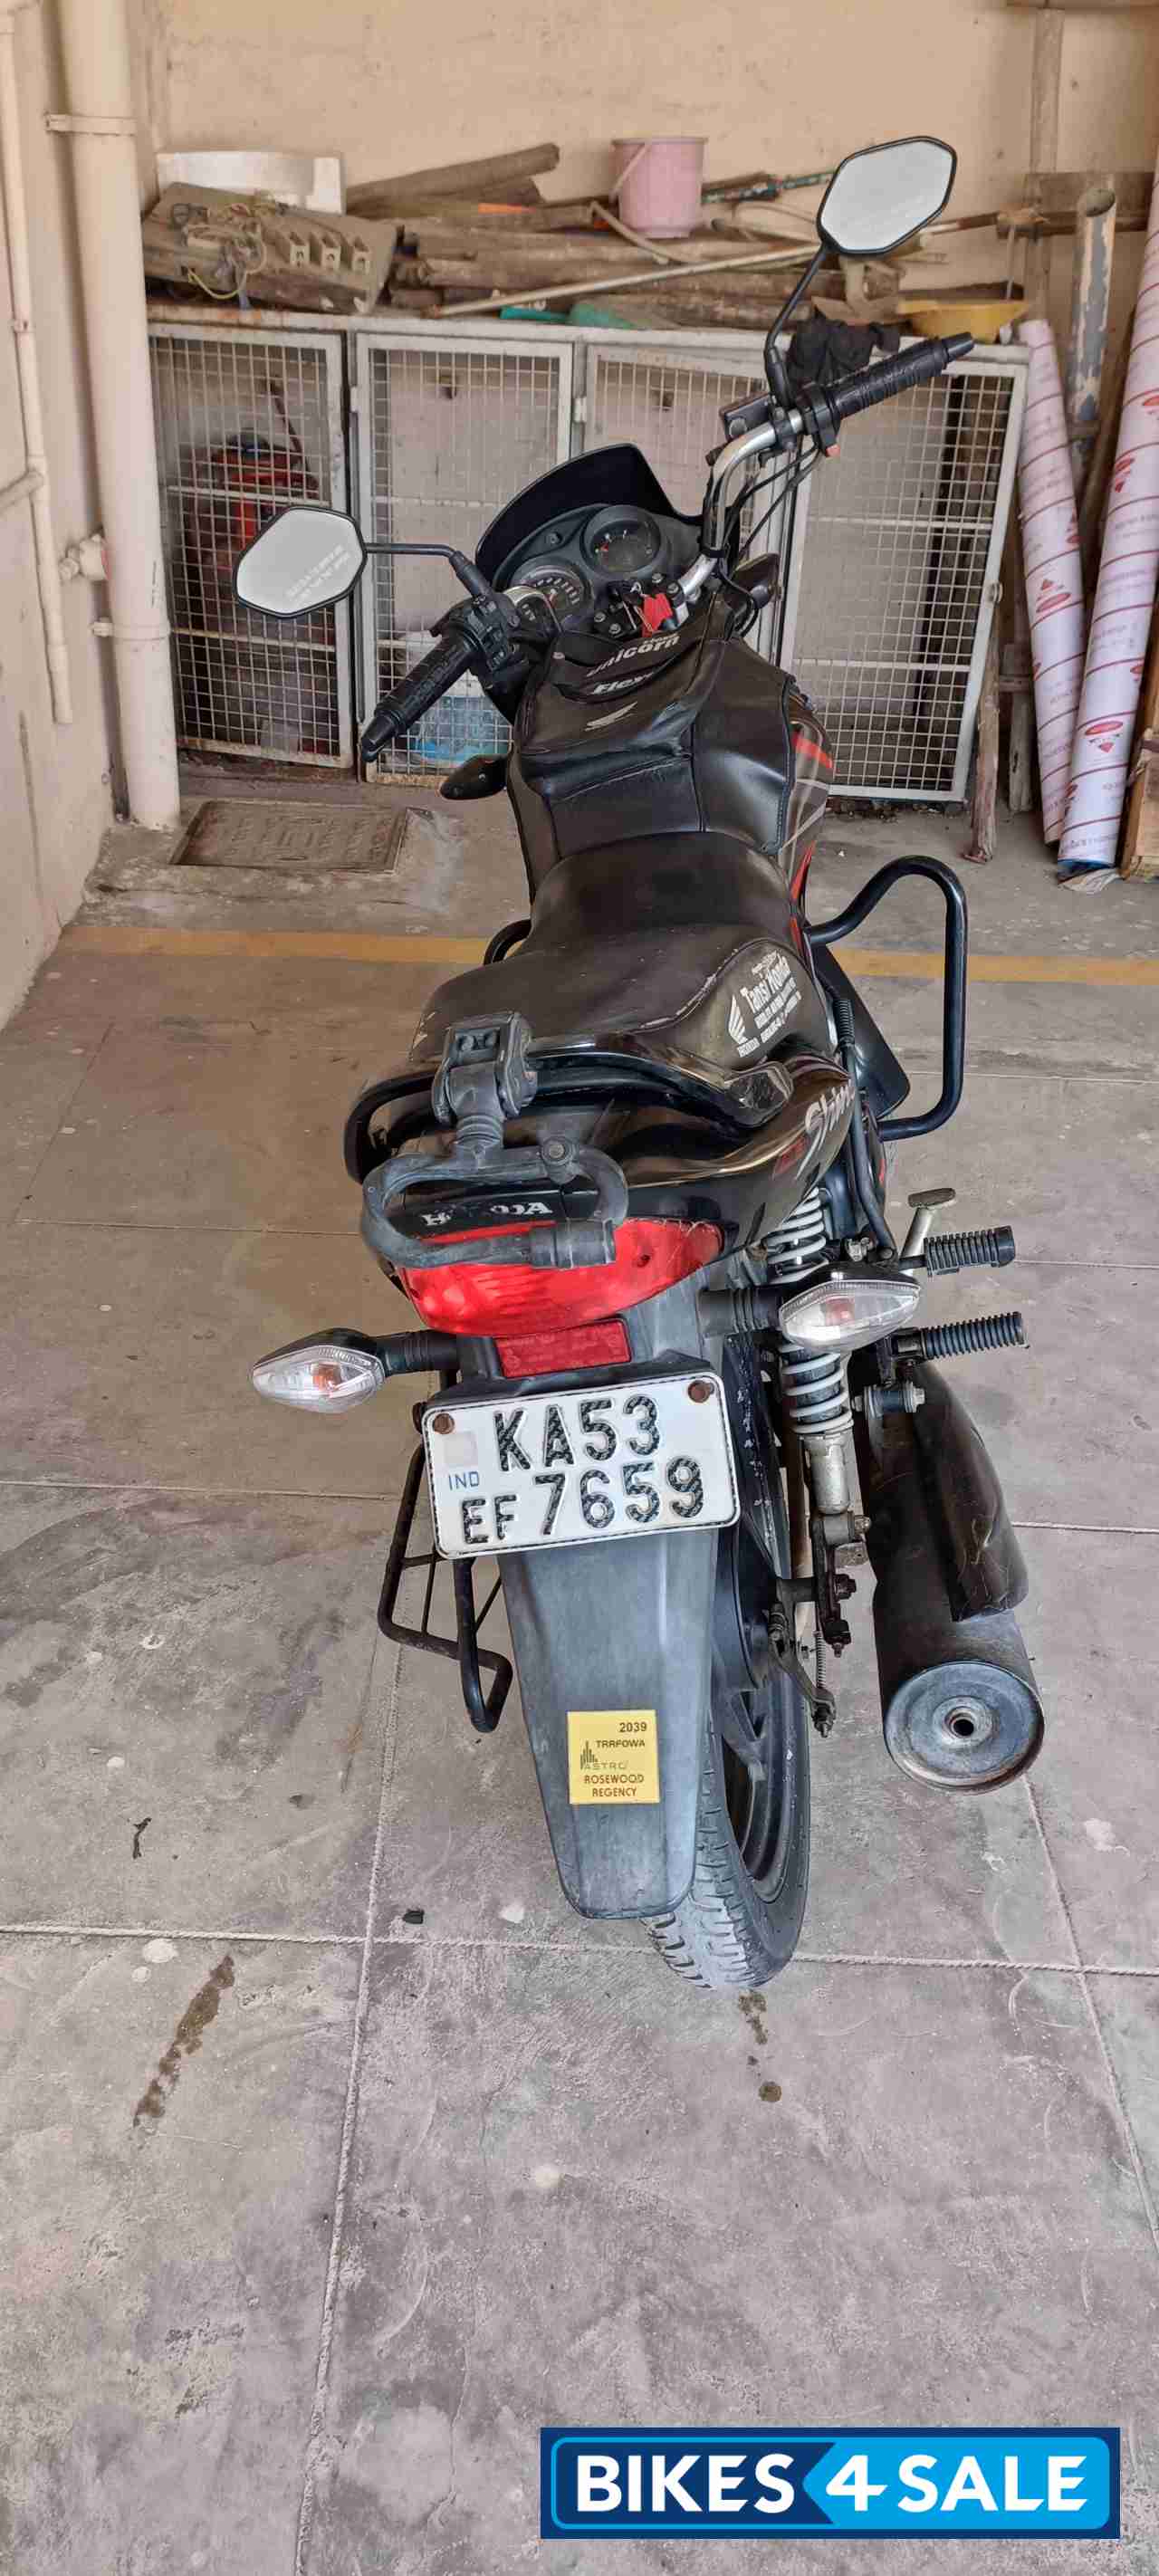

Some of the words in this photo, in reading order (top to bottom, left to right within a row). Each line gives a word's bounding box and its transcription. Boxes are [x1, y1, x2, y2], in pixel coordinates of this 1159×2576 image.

[493, 1395, 661, 1472] KA53
[448, 1470, 480, 1491] IND
[462, 1494, 518, 1544] EF
[533, 1456, 704, 1536] 7659
[618, 1721, 647, 1733] 2039
[583, 1774, 645, 1784] ROSEWOOD
[591, 1787, 637, 1797] REGENCY
